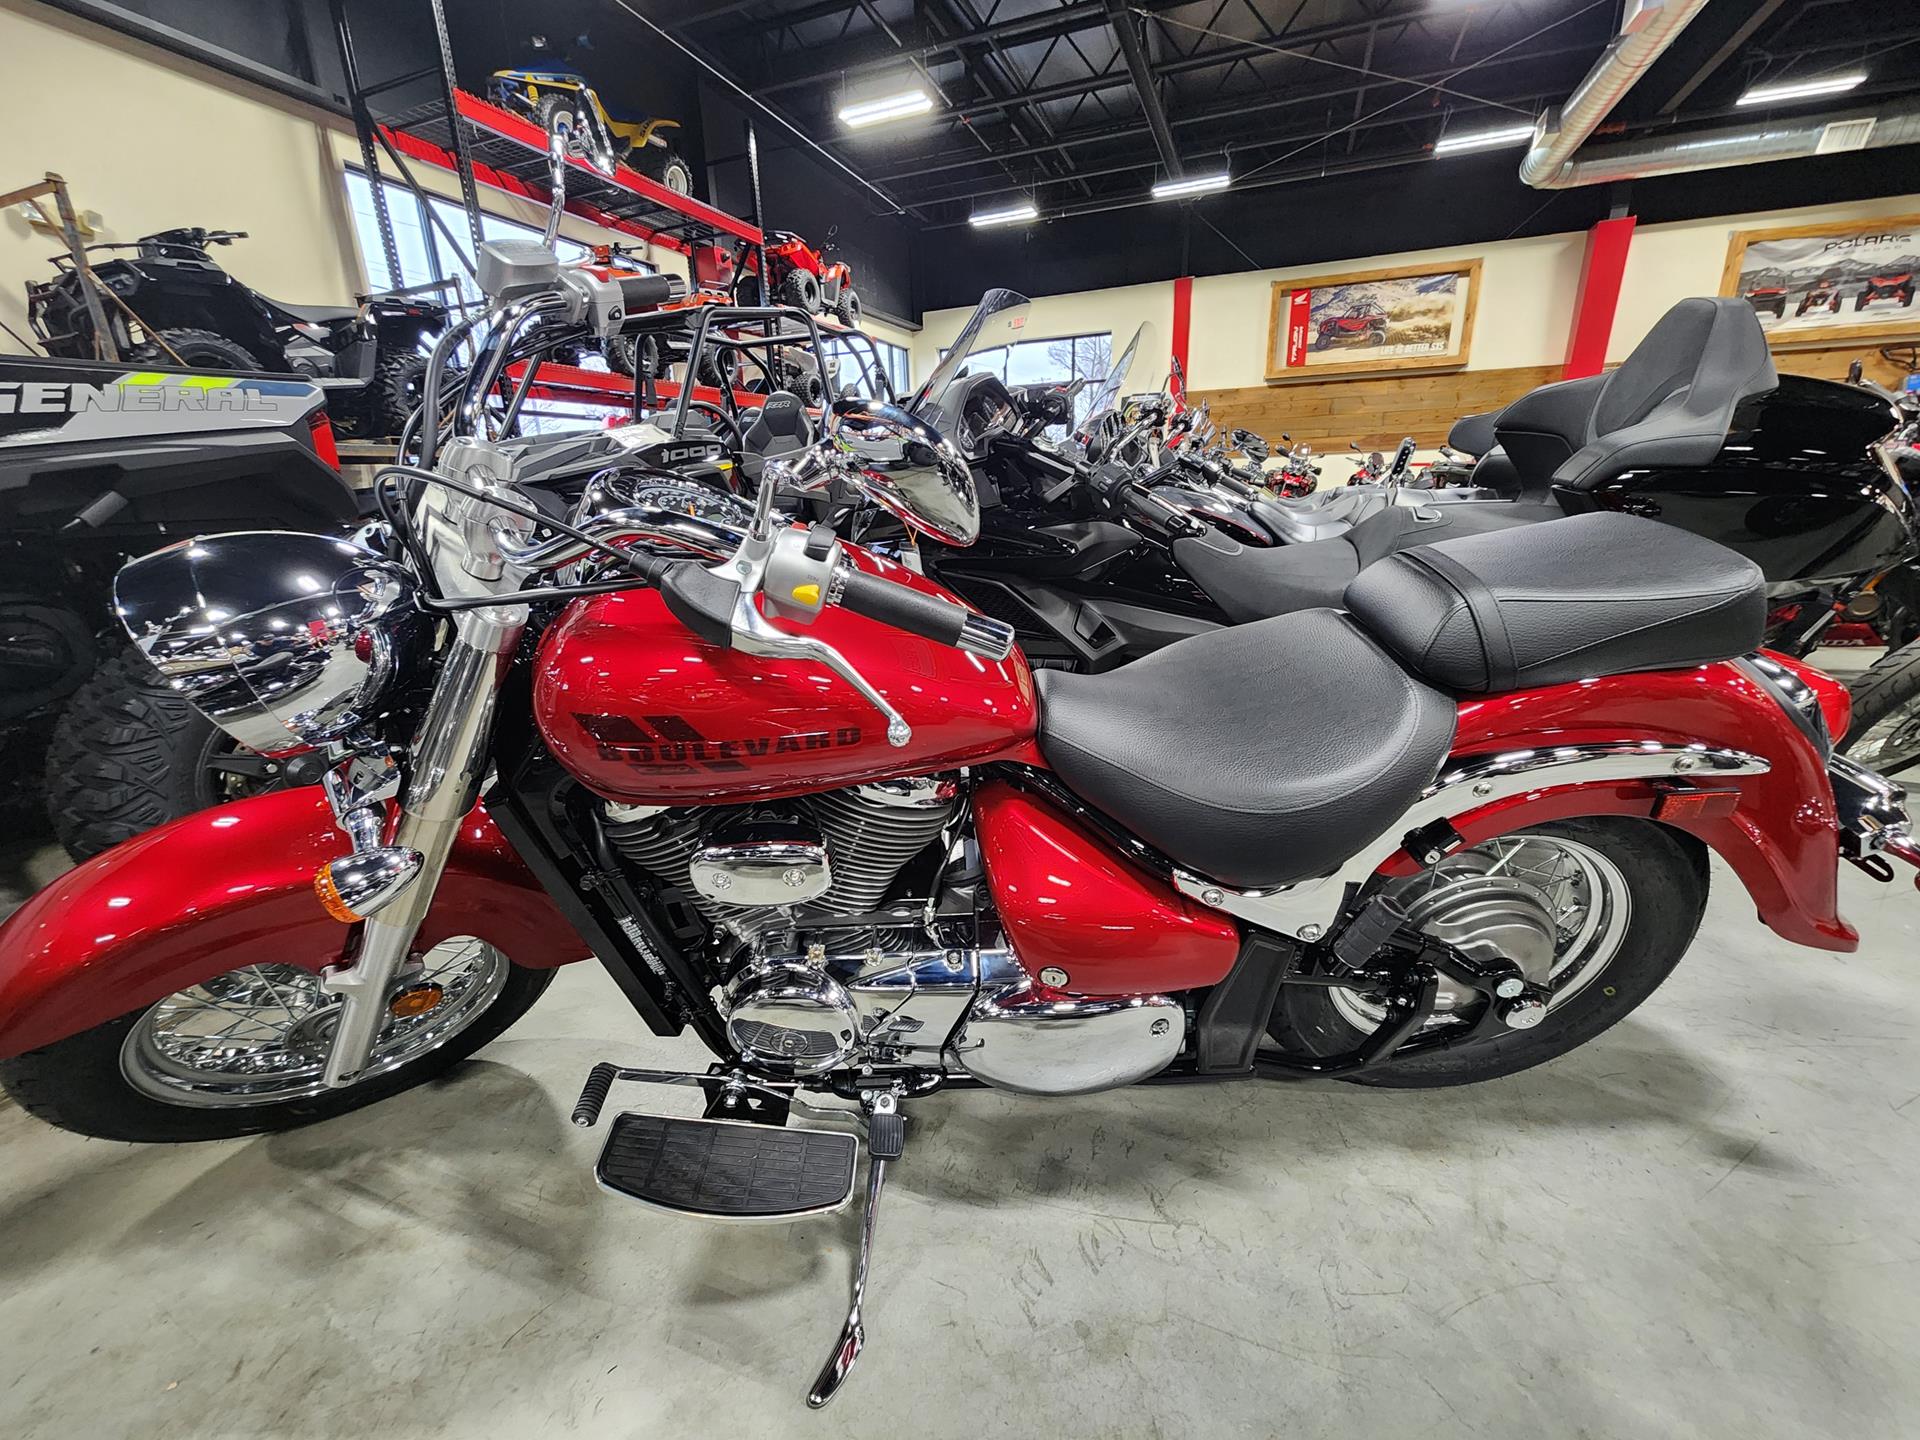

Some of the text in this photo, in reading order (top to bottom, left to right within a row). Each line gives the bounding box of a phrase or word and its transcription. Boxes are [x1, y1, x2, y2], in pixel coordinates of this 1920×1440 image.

[1823, 233, 1912, 252] POLARIS
[765, 400, 791, 410] RZR
[661, 444, 723, 463] 1000
[597, 727, 862, 763] BOULEVARD
